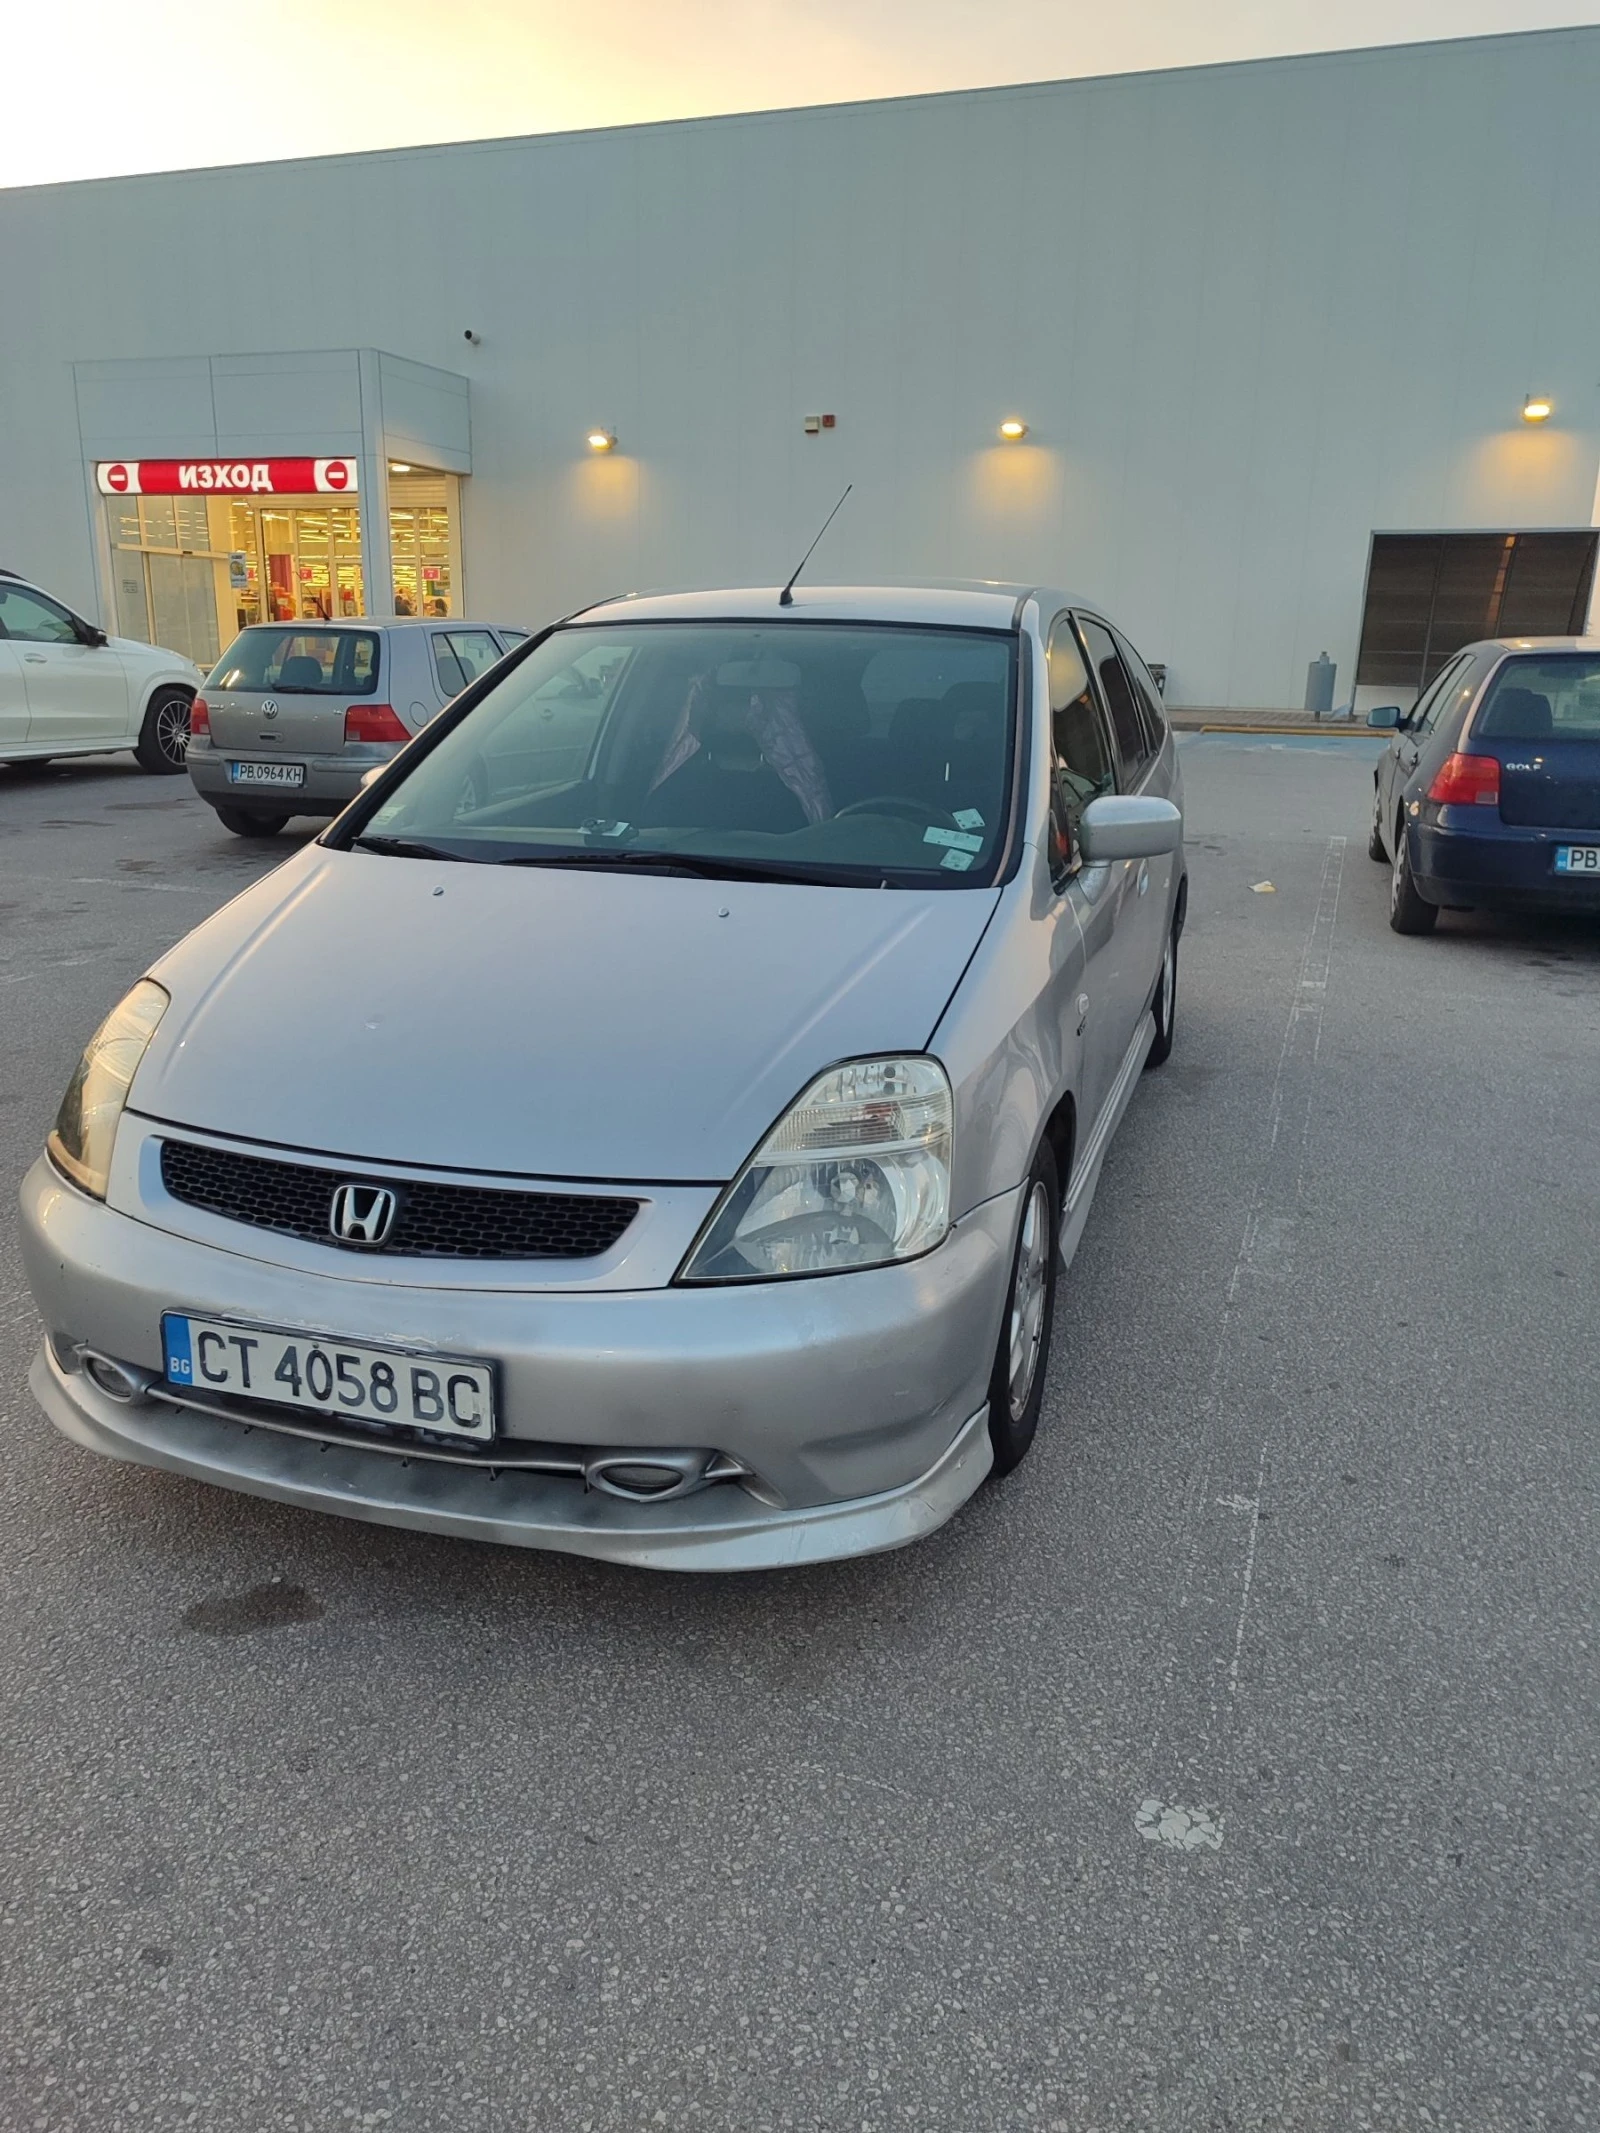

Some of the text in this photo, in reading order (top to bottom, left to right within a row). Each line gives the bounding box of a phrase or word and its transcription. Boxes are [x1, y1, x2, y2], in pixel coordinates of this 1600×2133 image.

[179, 464, 273, 492] ИЗХОД
[257, 766, 283, 779] 0964
[170, 1357, 190, 1374] BG
[198, 1331, 481, 1428] CT 4058 BC
